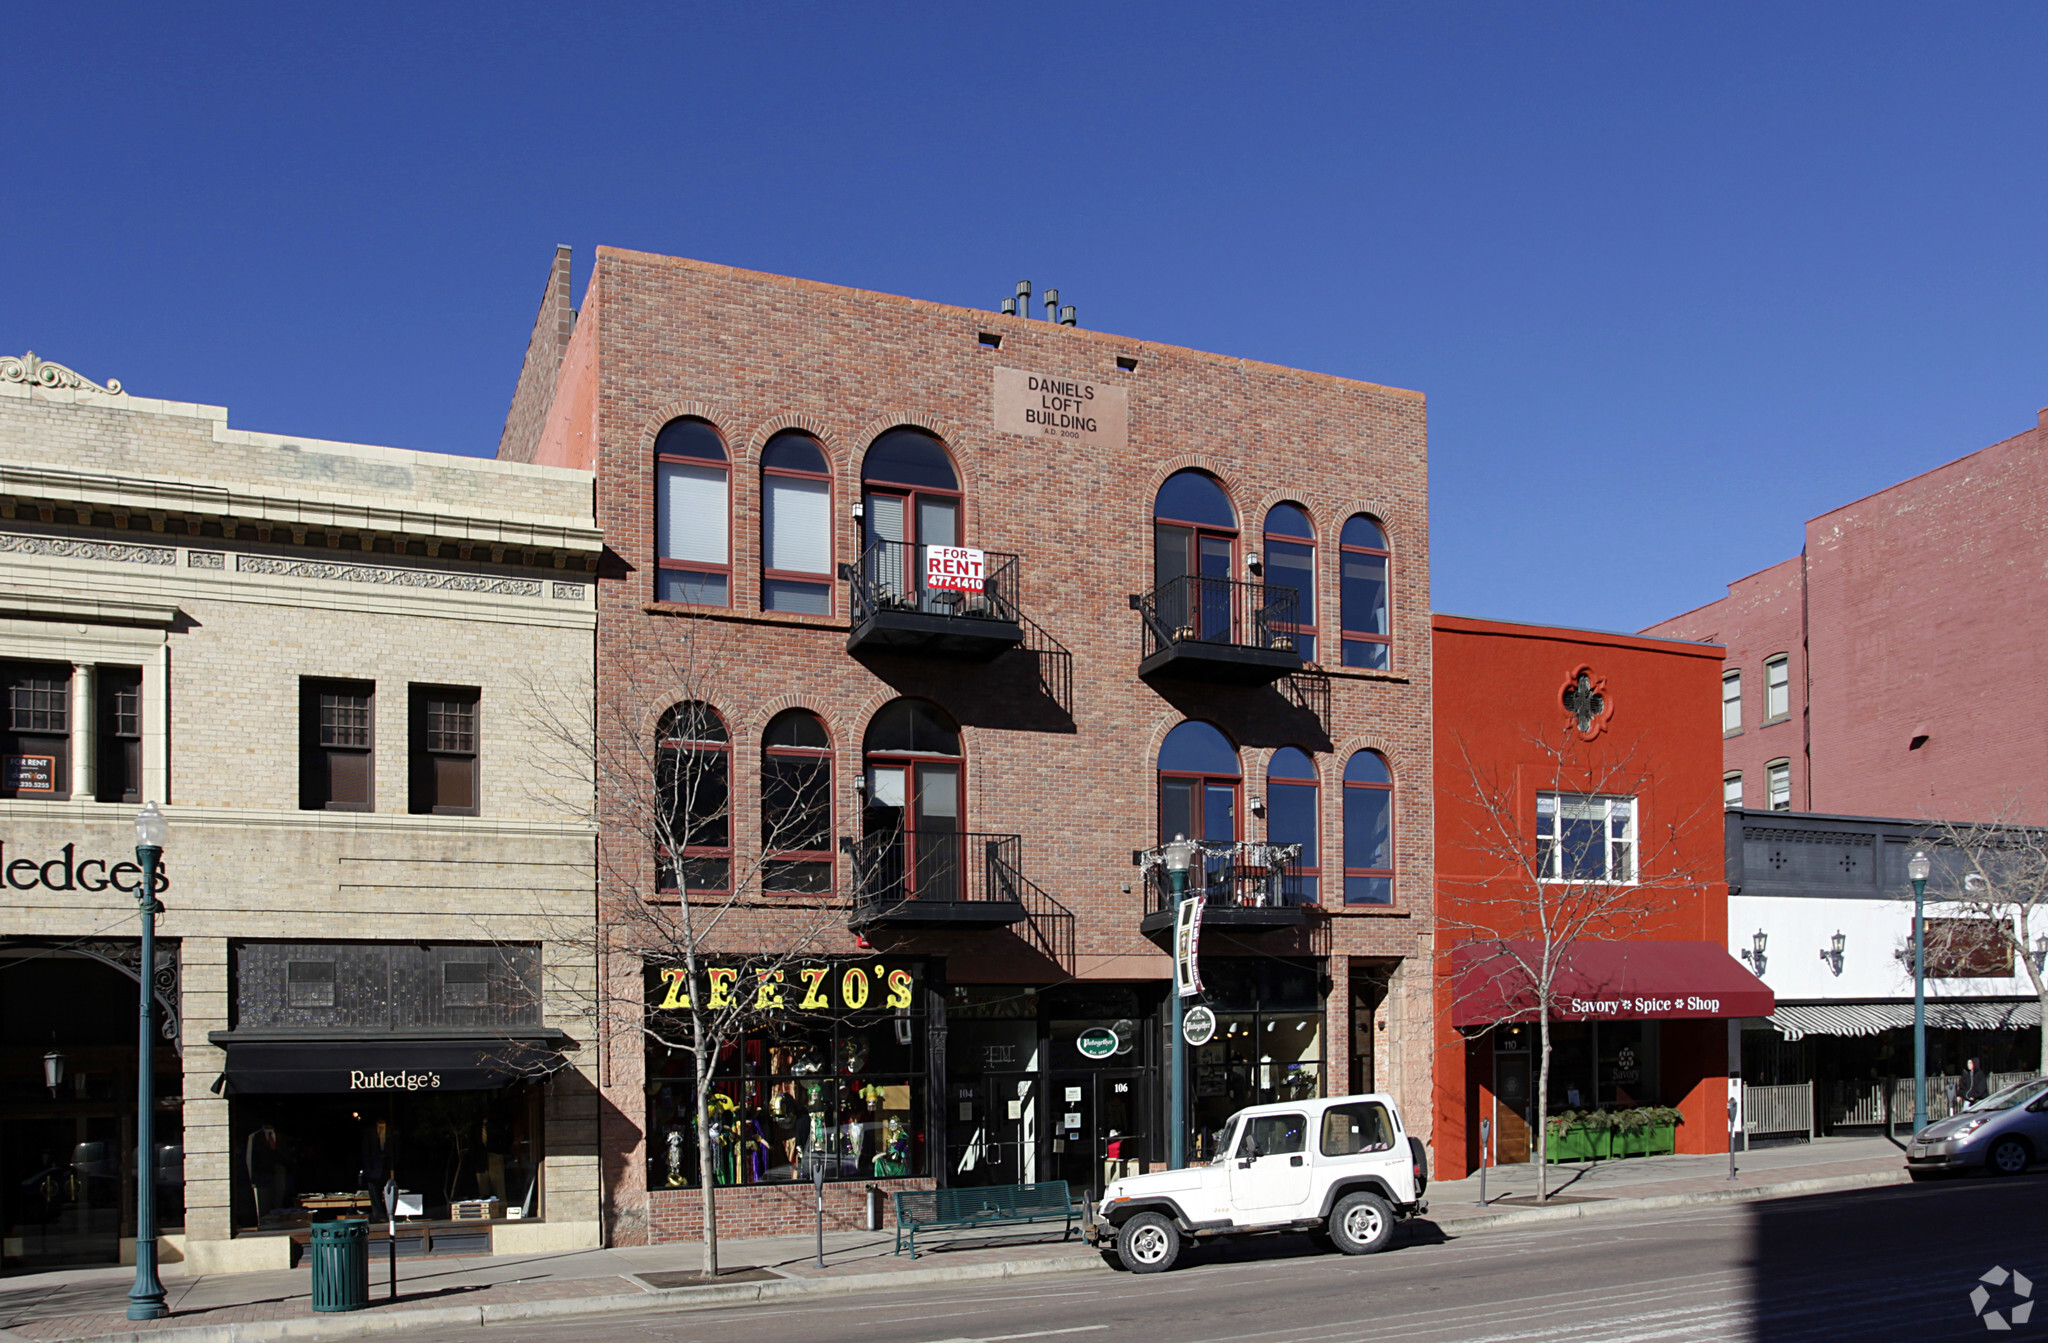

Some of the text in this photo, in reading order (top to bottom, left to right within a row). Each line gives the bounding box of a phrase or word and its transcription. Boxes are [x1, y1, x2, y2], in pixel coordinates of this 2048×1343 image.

[1028, 376, 1094, 400] DANIELS
[1042, 394, 1083, 414] LOFT
[1025, 408, 1097, 433] BUILDING
[1044, 427, 1080, 439] A.D. 2000
[929, 557, 983, 577] RENT
[928, 575, 983, 590] 477-1410
[10, 758, 48, 767] FOR RENT
[658, 965, 913, 1009] ZEEZO'S
[1571, 996, 1720, 1015] Savory Spice Shop
[1503, 1040, 1517, 1050] 110
[350, 1070, 440, 1091] Rutledge's
[1612, 1067, 1640, 1081] Savory
[959, 1088, 974, 1098] 104
[1114, 1083, 1128, 1093] 106
